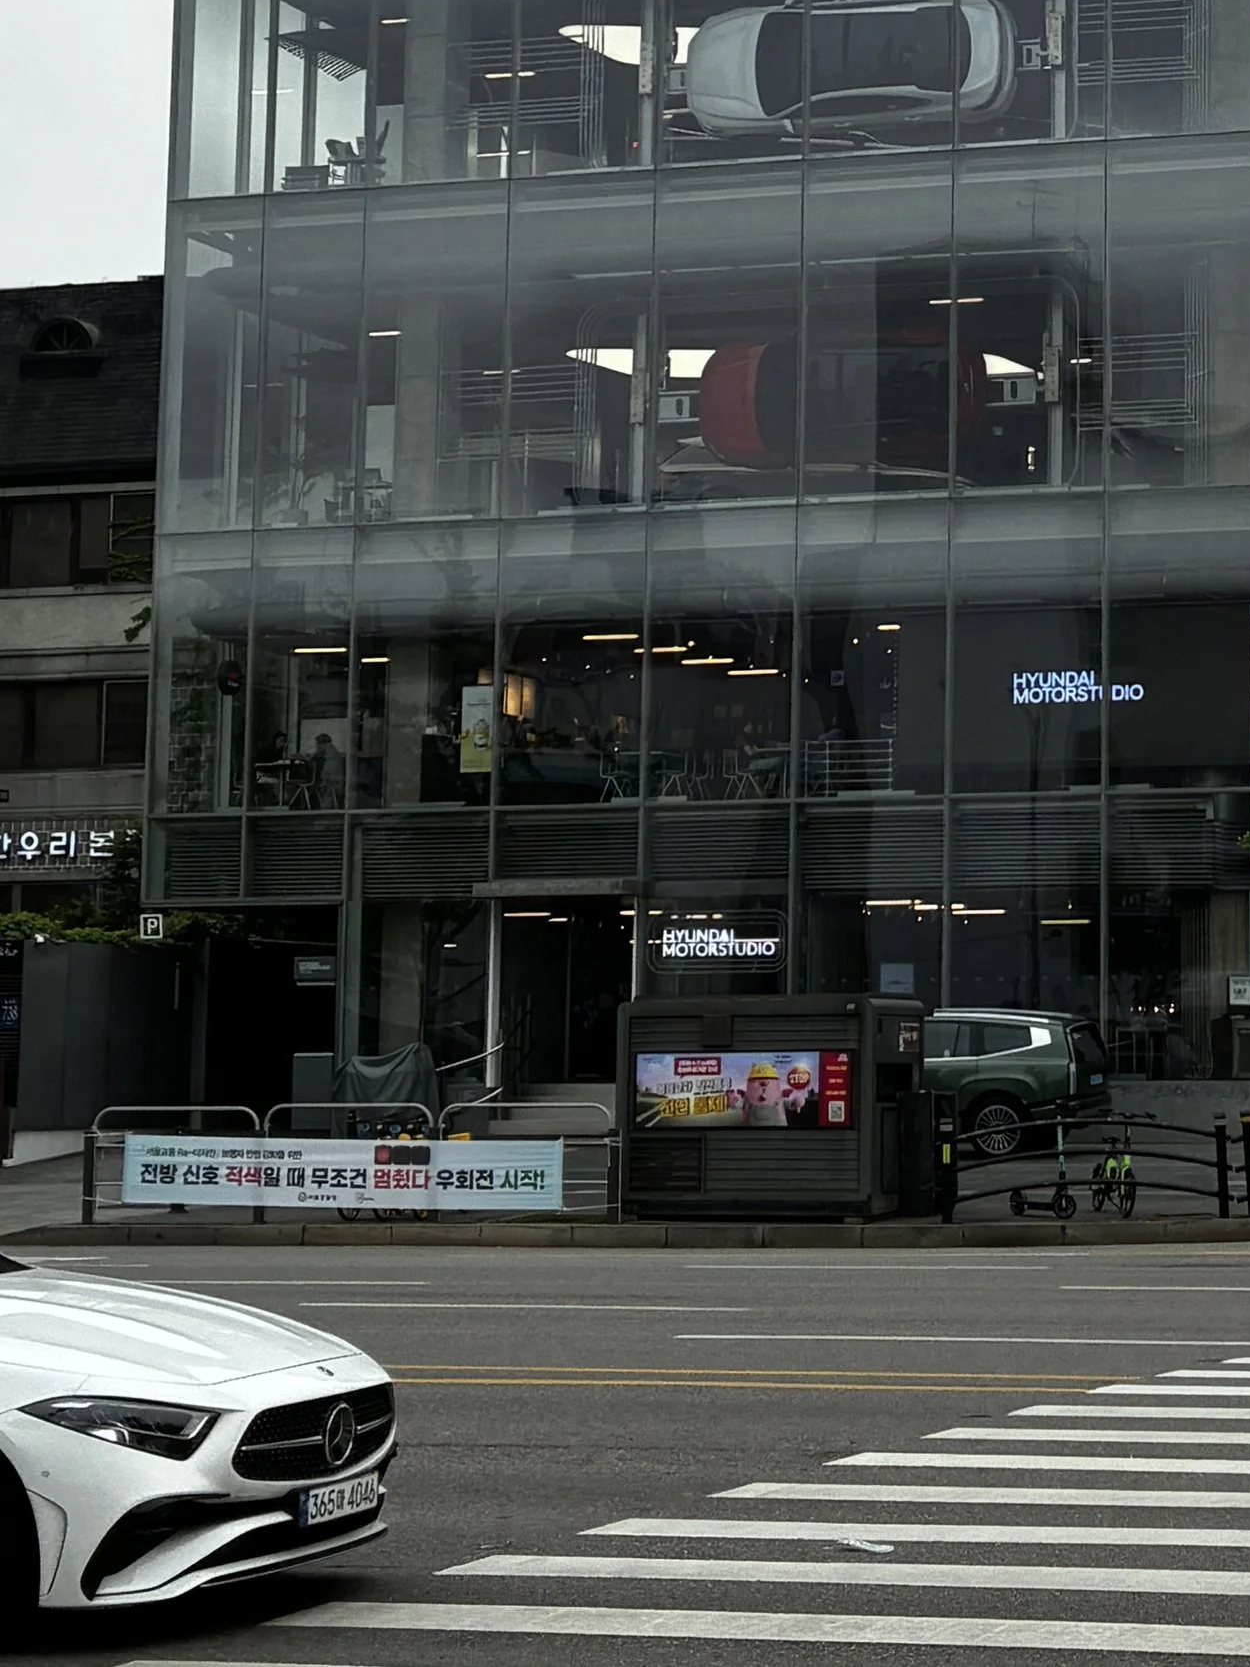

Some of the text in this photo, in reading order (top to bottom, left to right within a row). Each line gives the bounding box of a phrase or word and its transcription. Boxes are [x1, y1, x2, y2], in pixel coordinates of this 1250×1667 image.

[1013, 670, 1095, 688] HYUNDAI
[662, 929, 735, 943] HYUNDAI
[662, 942, 776, 957] MOTORSTUDIO
[140, 1163, 545, 1190] 전방 신호 적색일 때 무조건 멈췄다 우회전 시작!
